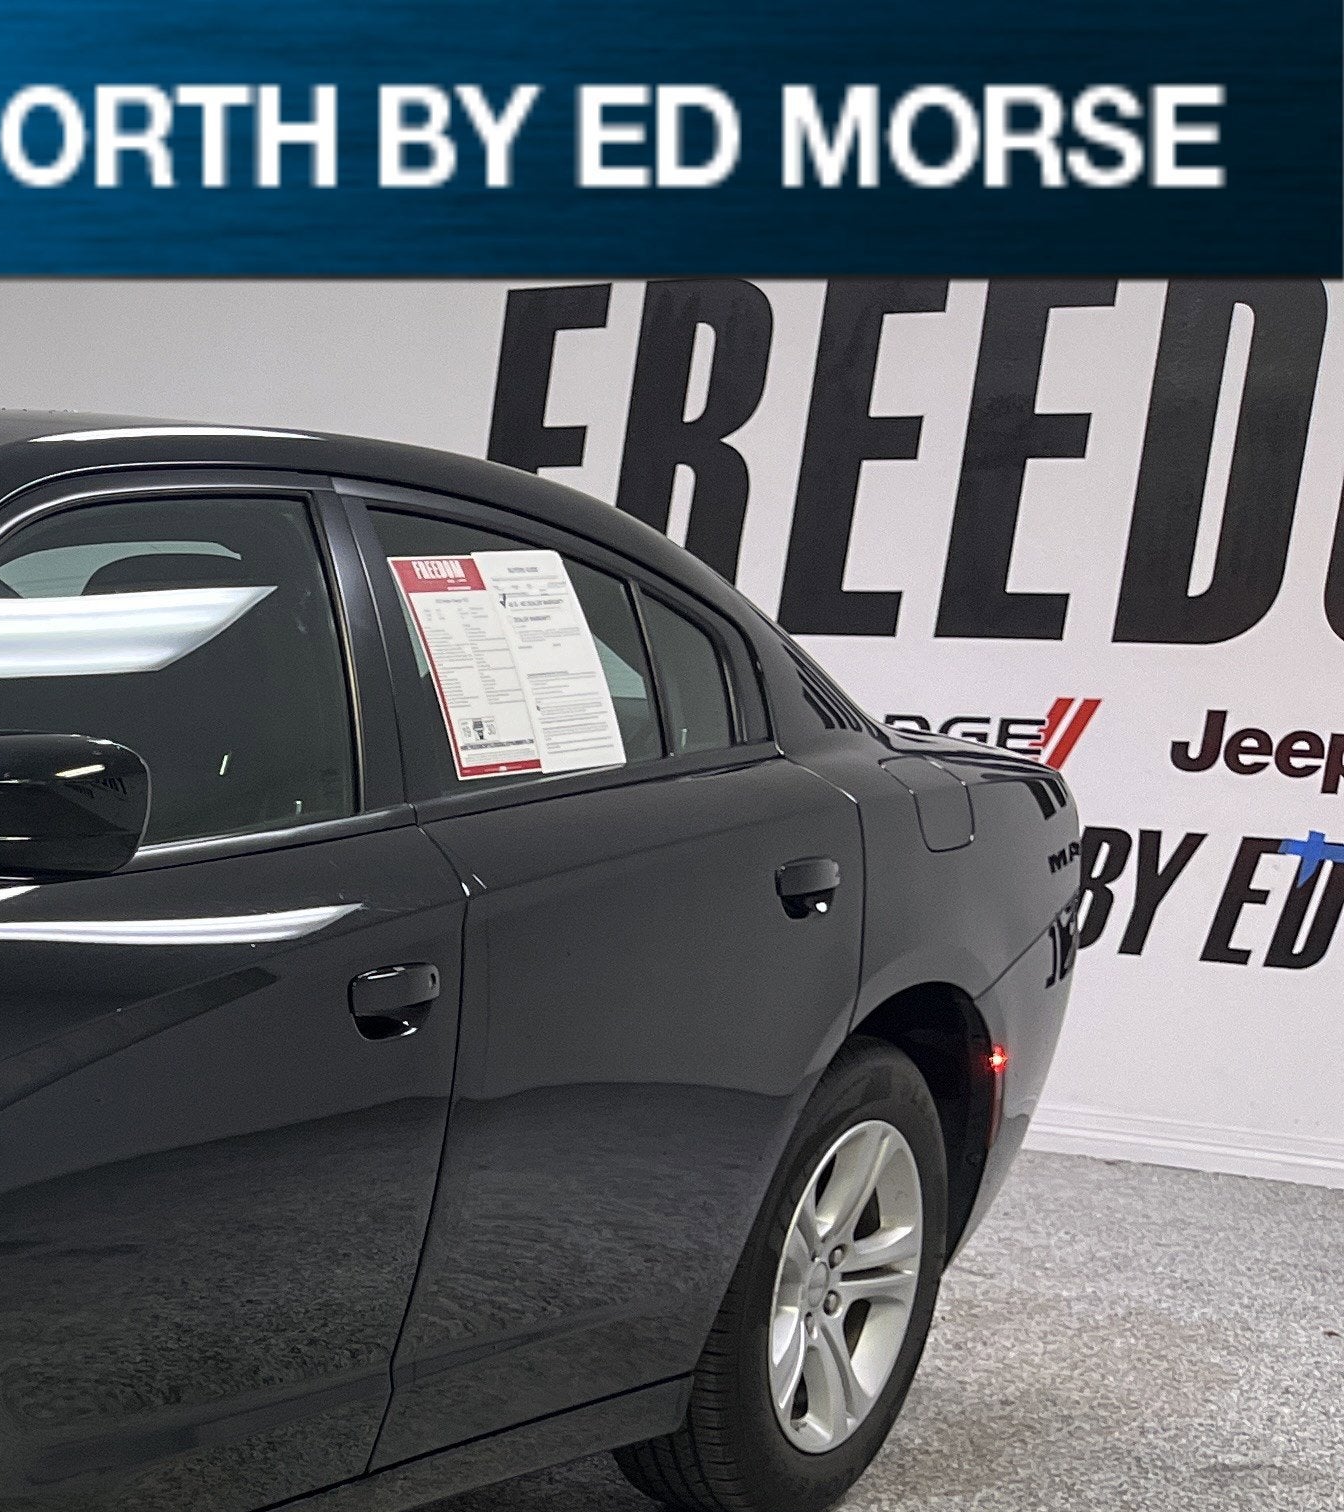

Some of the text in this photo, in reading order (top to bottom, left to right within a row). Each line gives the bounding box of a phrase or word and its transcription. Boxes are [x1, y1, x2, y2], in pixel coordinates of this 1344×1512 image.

[485, 277, 1344, 645] FREED
[1076, 825, 1344, 970] BY ED
